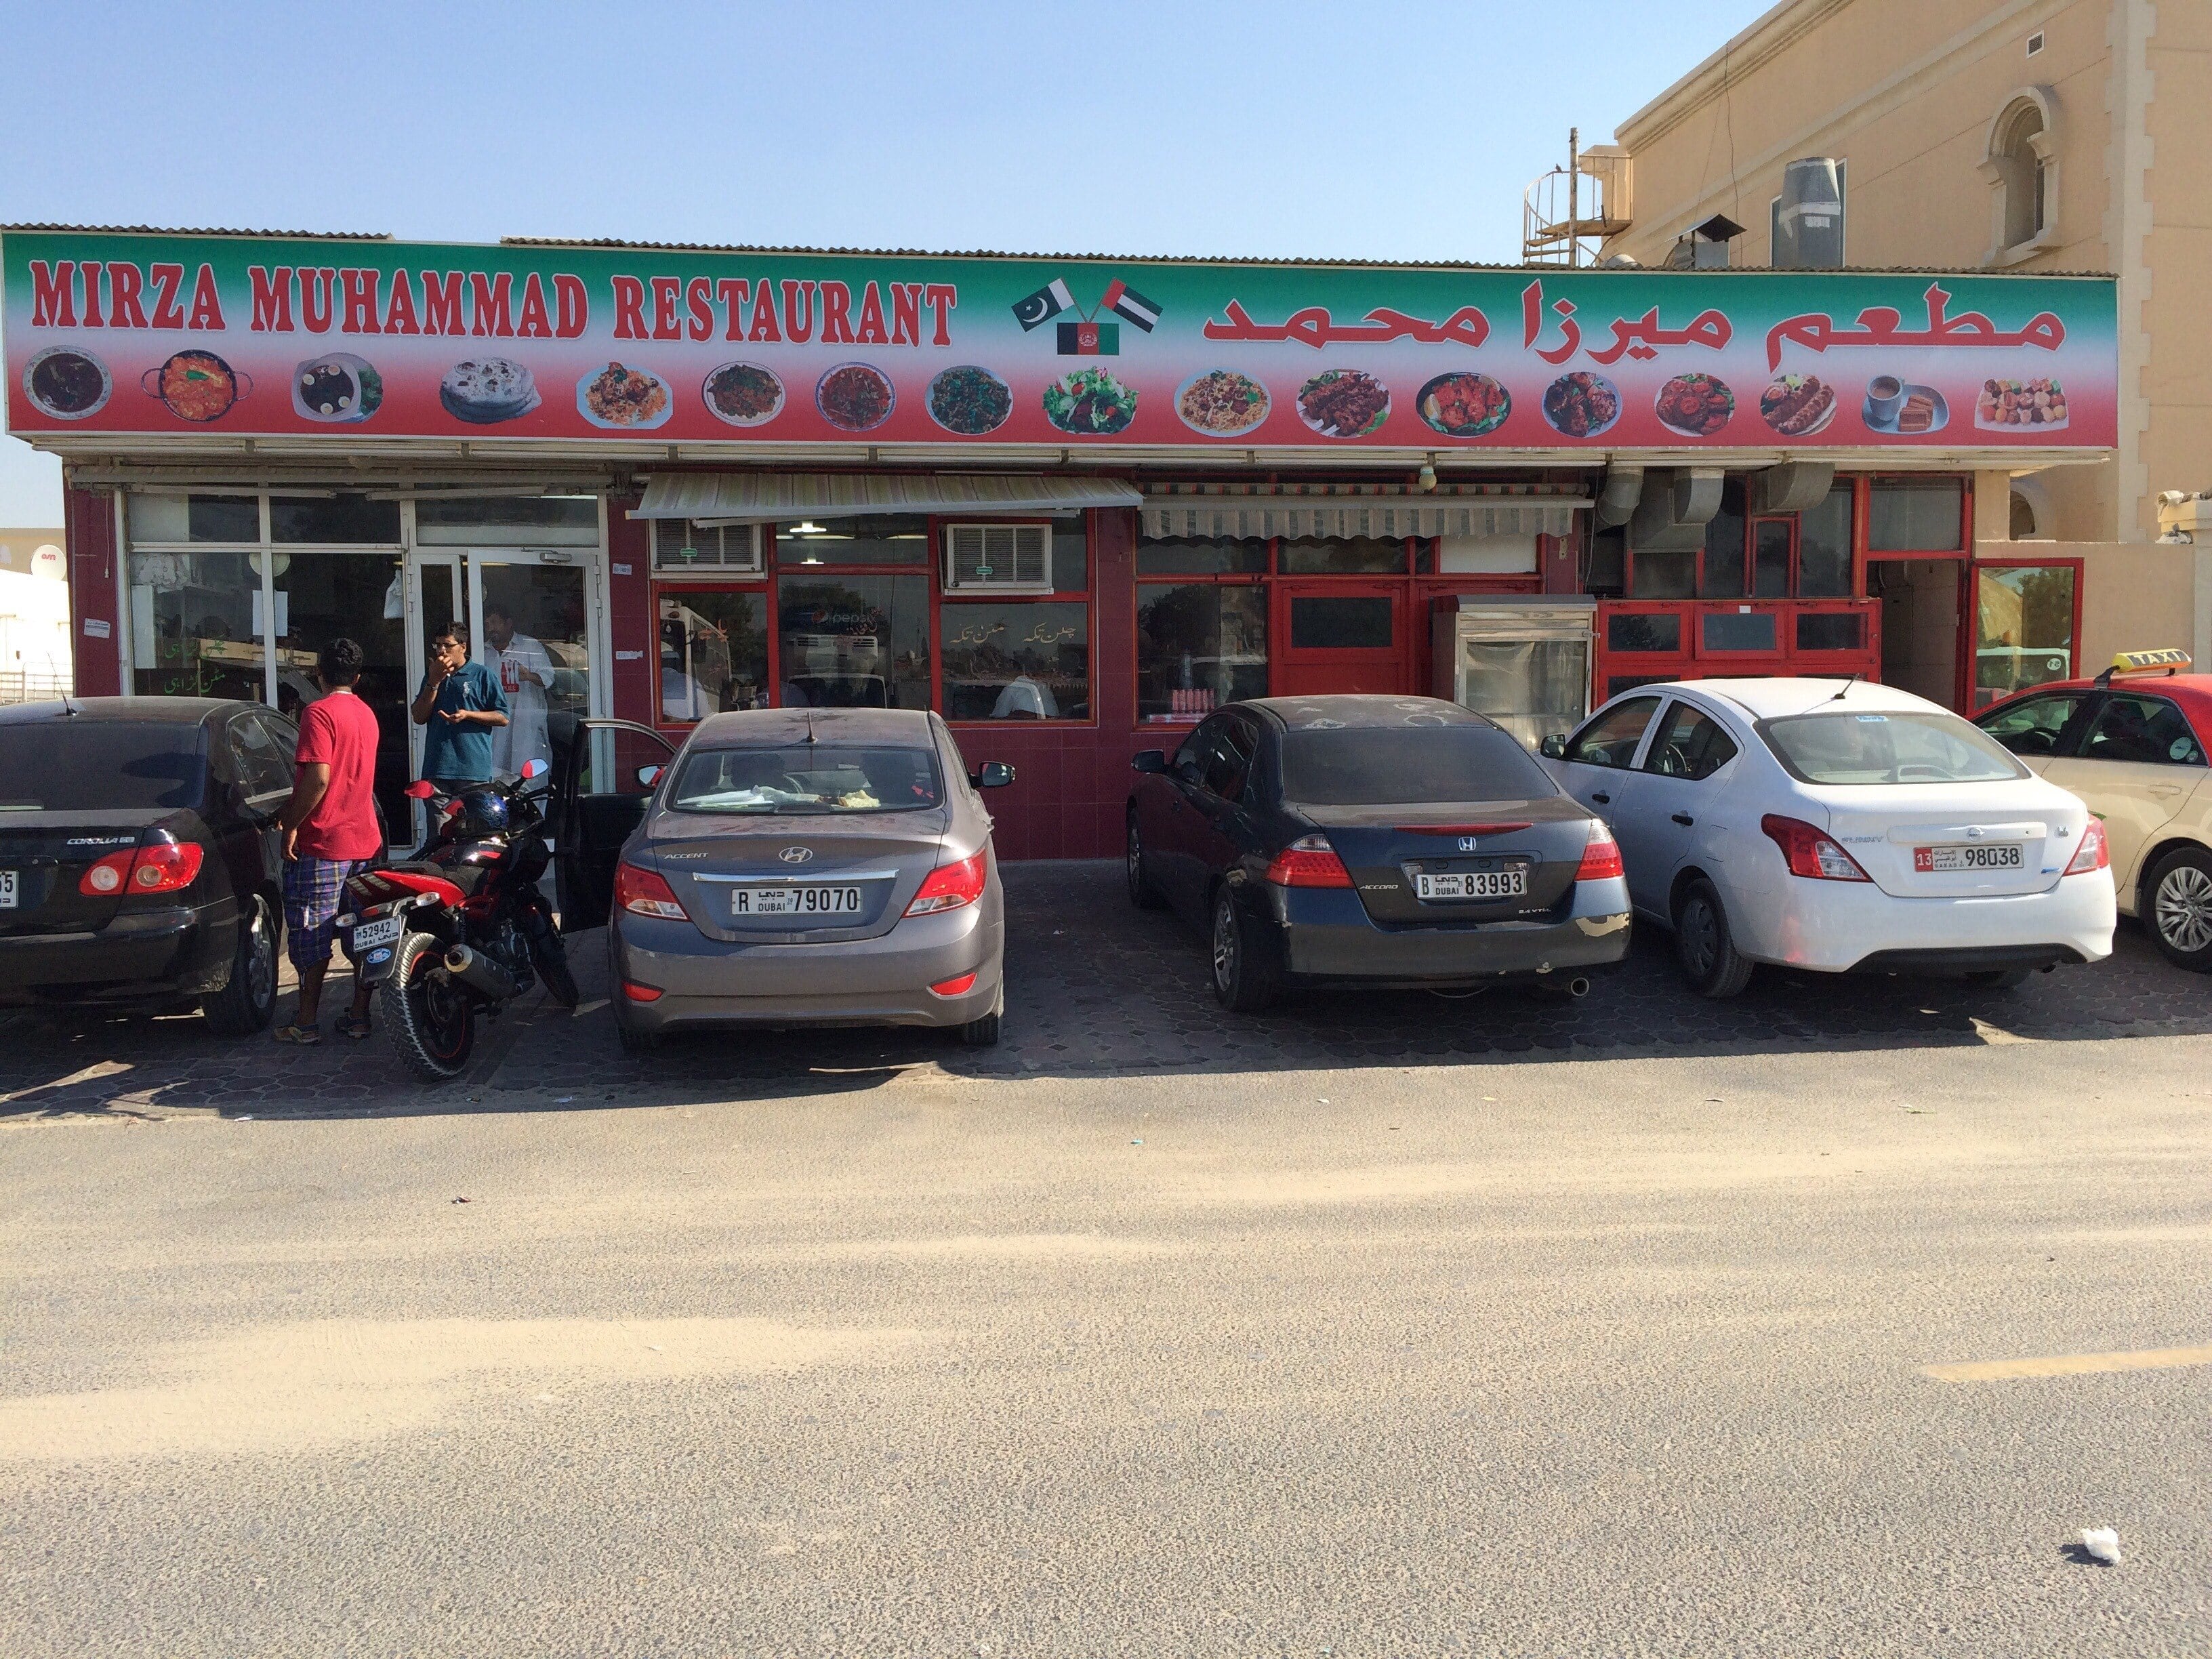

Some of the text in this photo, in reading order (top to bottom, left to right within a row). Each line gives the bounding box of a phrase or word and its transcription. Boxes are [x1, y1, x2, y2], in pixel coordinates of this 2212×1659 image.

[28, 260, 958, 348] MIRZA MUHAMMAD RESTAURANT
[1202, 278, 2068, 375] مطعم ميرزا محمد
[2133, 651, 2182, 665] TAXI
[1917, 853, 1931, 866] 13
[1965, 847, 2020, 867] 98038
[1423, 876, 1430, 895] B
[1435, 887, 1459, 895] DUBAI
[1465, 872, 1523, 895] 83993
[739, 891, 749, 912] R
[758, 903, 786, 912] DUBAI
[792, 888, 858, 912] 79070
[363, 921, 391, 939] 52942
[354, 939, 375, 949] DUBAI
